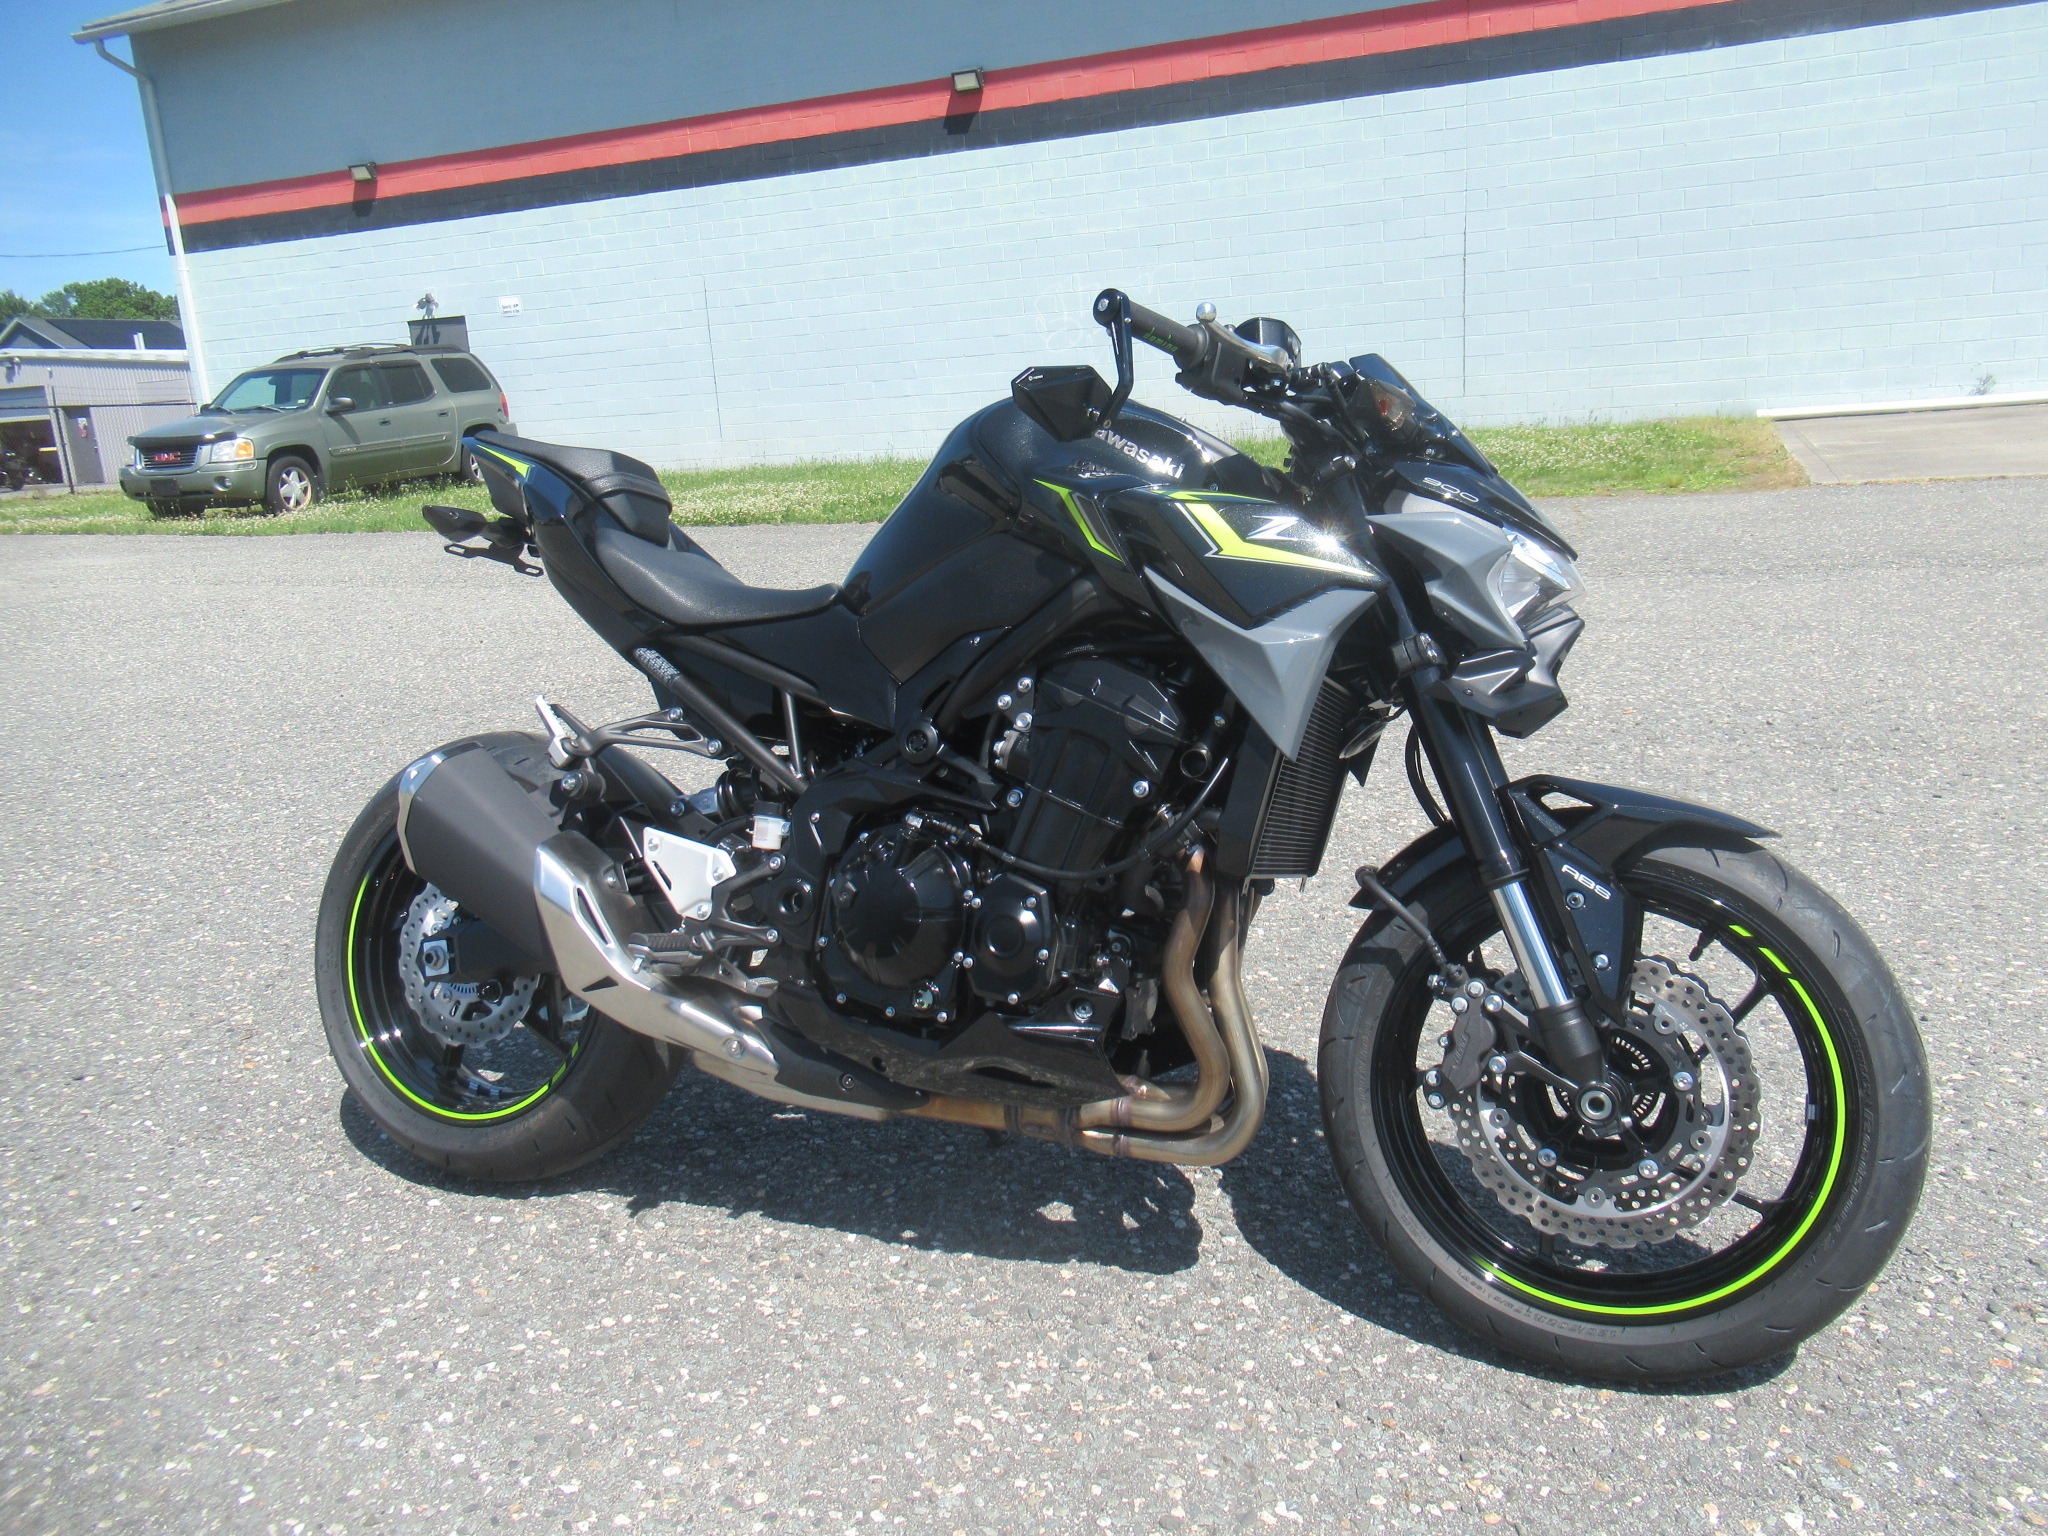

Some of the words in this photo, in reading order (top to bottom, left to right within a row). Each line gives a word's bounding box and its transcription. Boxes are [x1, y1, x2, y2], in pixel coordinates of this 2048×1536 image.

[1143, 326, 1178, 352] domino
[1094, 428, 1186, 479] awasaki
[1422, 476, 1479, 503] 900
[1561, 864, 1612, 900] ABS
